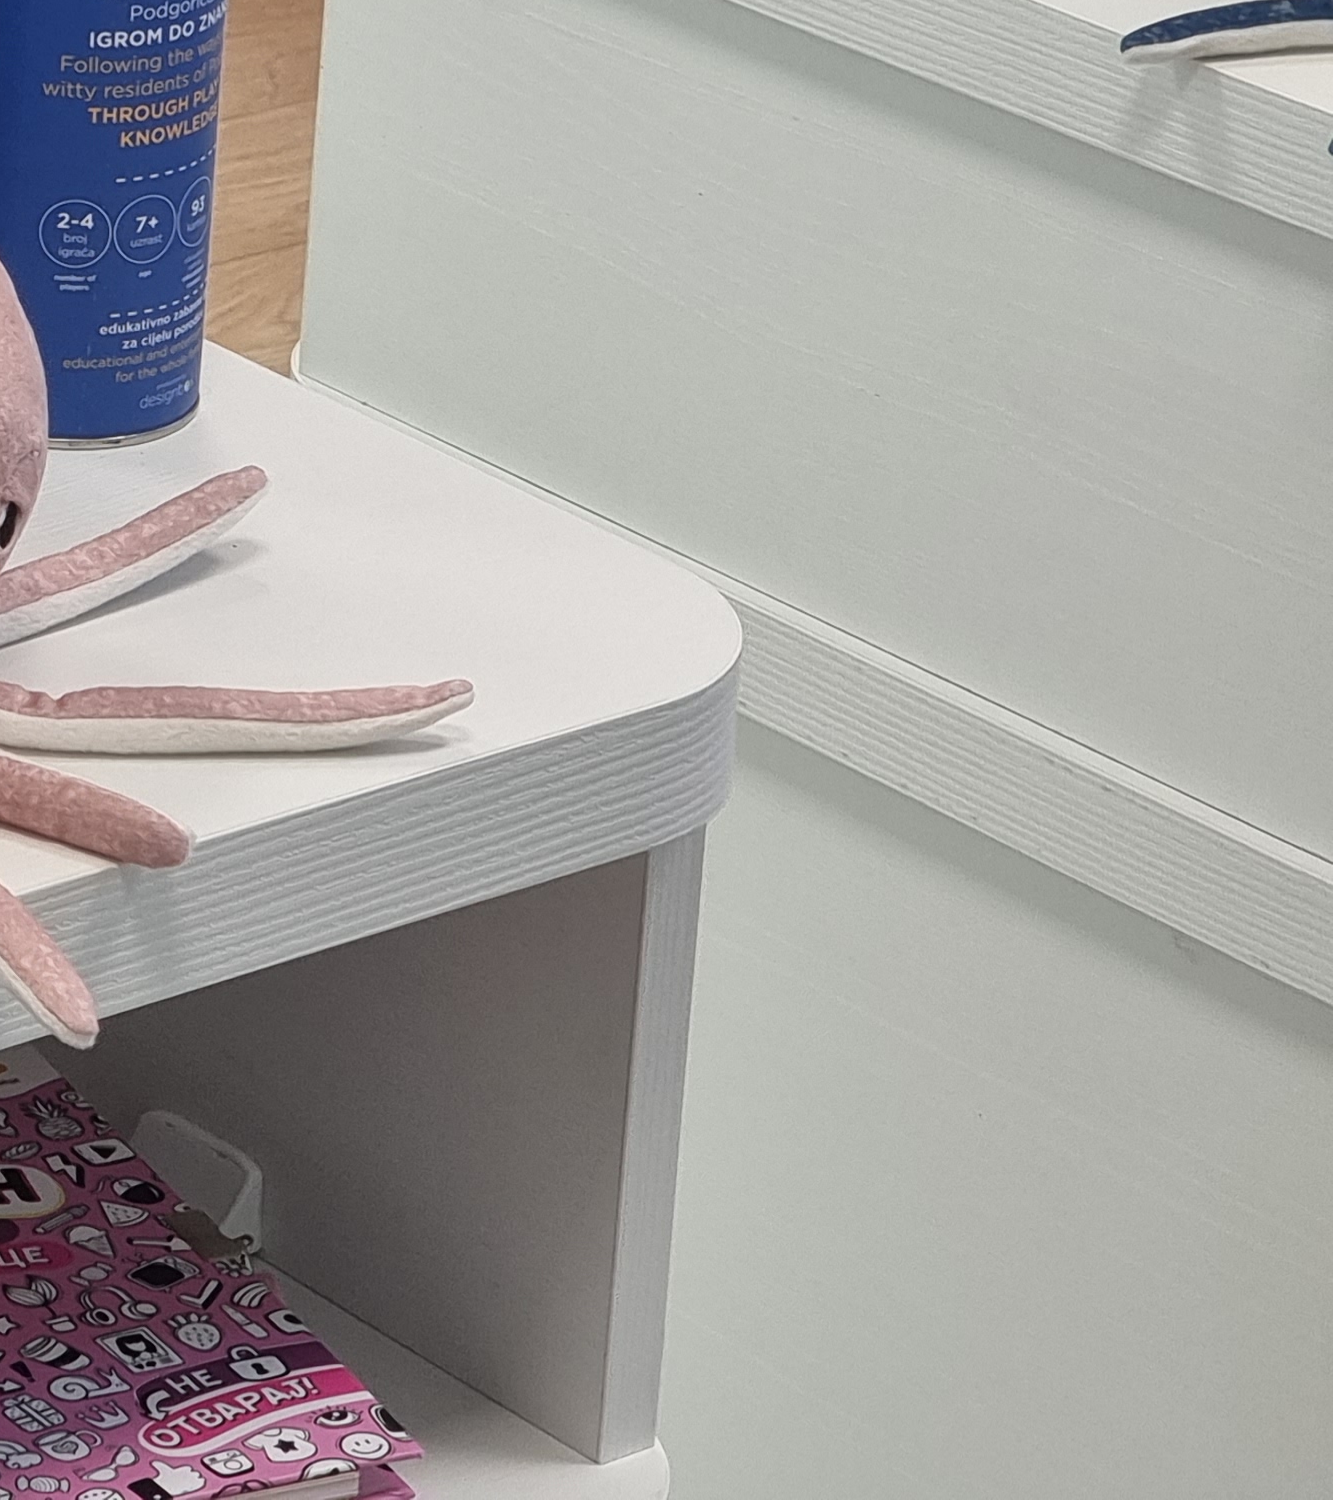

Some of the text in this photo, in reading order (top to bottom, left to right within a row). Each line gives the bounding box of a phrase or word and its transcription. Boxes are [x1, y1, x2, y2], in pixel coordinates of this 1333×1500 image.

[89, 27, 162, 49] IGROM
[168, 20, 195, 41] DO
[60, 46, 194, 75] Following the
[43, 64, 207, 102] witty residents of
[88, 96, 189, 124] THROUGH
[57, 212, 94, 230] 2-4
[135, 216, 159, 234] 7+
[63, 233, 88, 244] broj
[99, 316, 172, 336] edukativno
[122, 339, 138, 350] za
[141, 330, 172, 348] cijelu
[63, 348, 168, 369] educational and
[115, 371, 134, 383] for
[137, 367, 157, 380] the
[168, 1369, 223, 1395] НЕ
[149, 1377, 318, 1448] ОТВАРАЈ!
